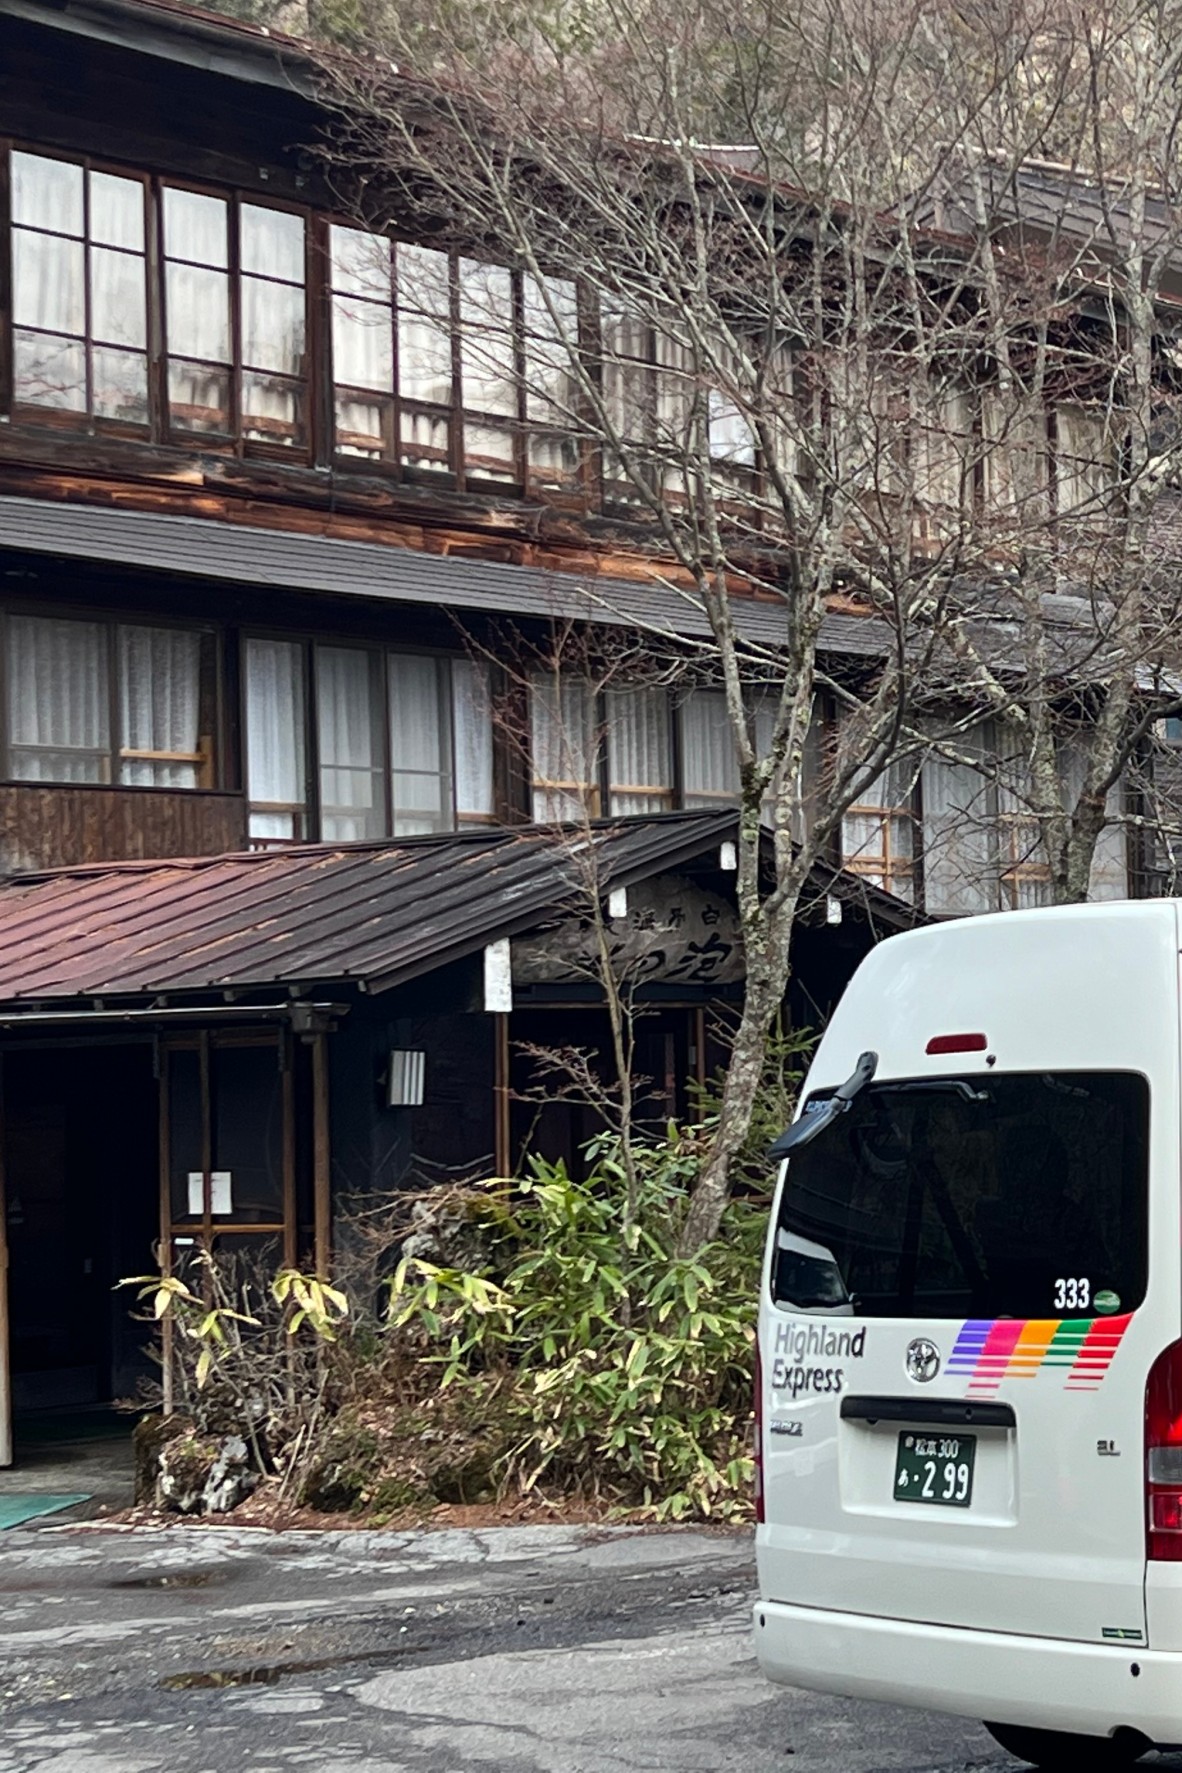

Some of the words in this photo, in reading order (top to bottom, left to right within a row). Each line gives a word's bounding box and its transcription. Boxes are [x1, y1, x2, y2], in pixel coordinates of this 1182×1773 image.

[1054, 1277, 1090, 1309] 333
[774, 1322, 867, 1363] Highland
[771, 1358, 844, 1399] Express
[937, 1439, 960, 1458] 300
